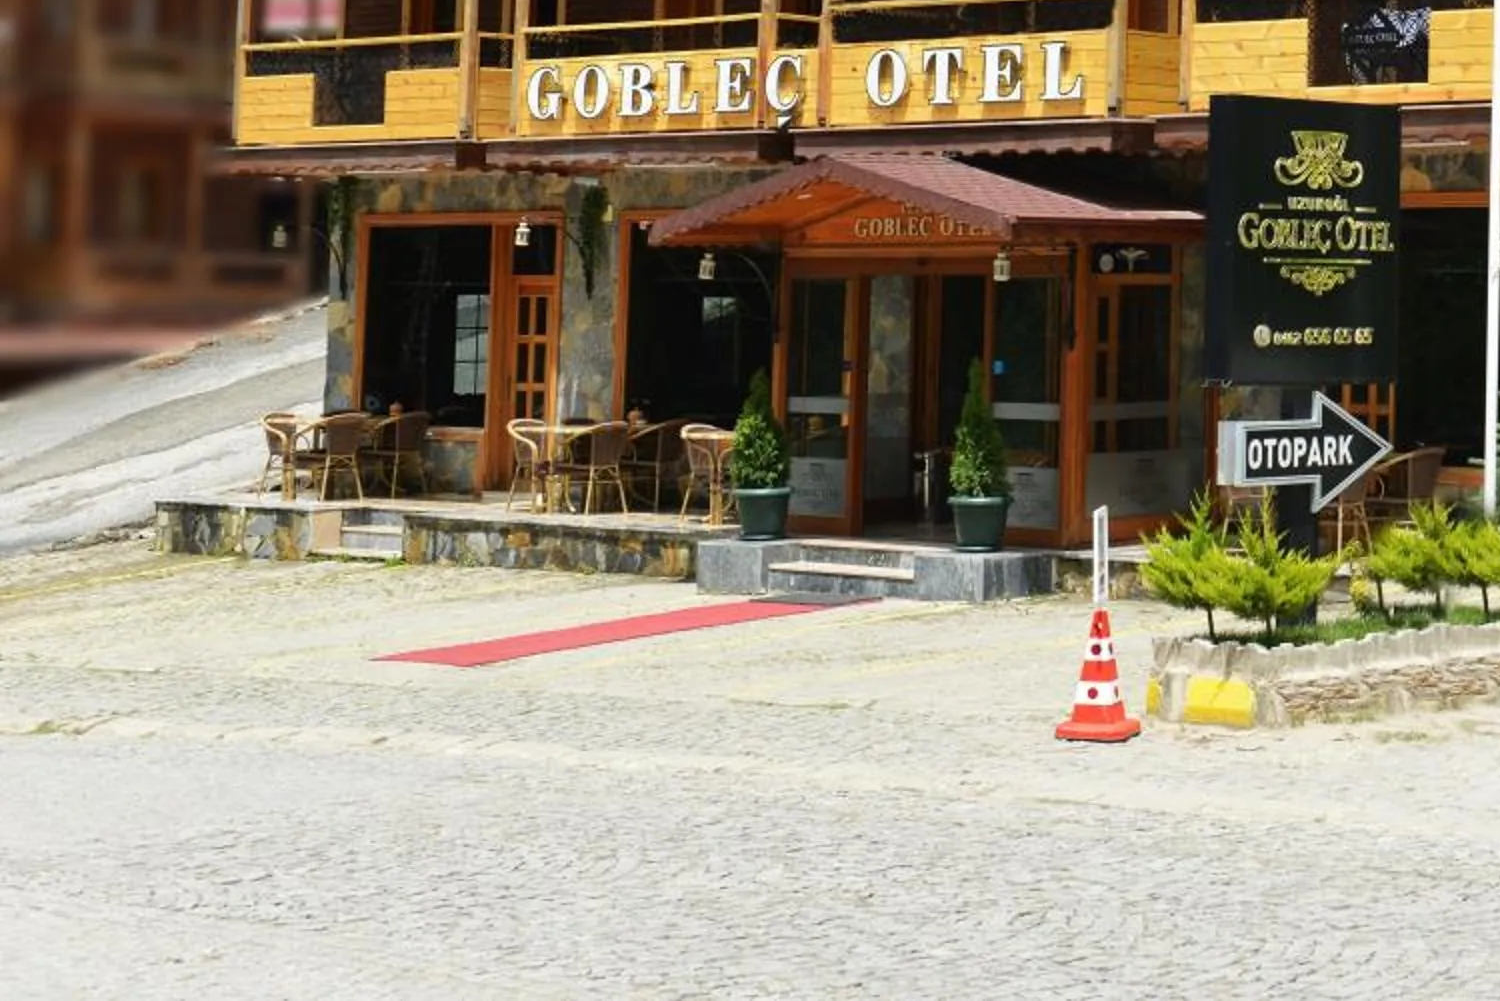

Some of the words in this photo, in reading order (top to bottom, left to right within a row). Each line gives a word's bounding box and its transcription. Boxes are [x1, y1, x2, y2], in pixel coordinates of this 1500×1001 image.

[528, 55, 804, 129] GOBLEÇ
[865, 42, 1085, 107] OTEL
[1249, 434, 1353, 470] OTOPARK
